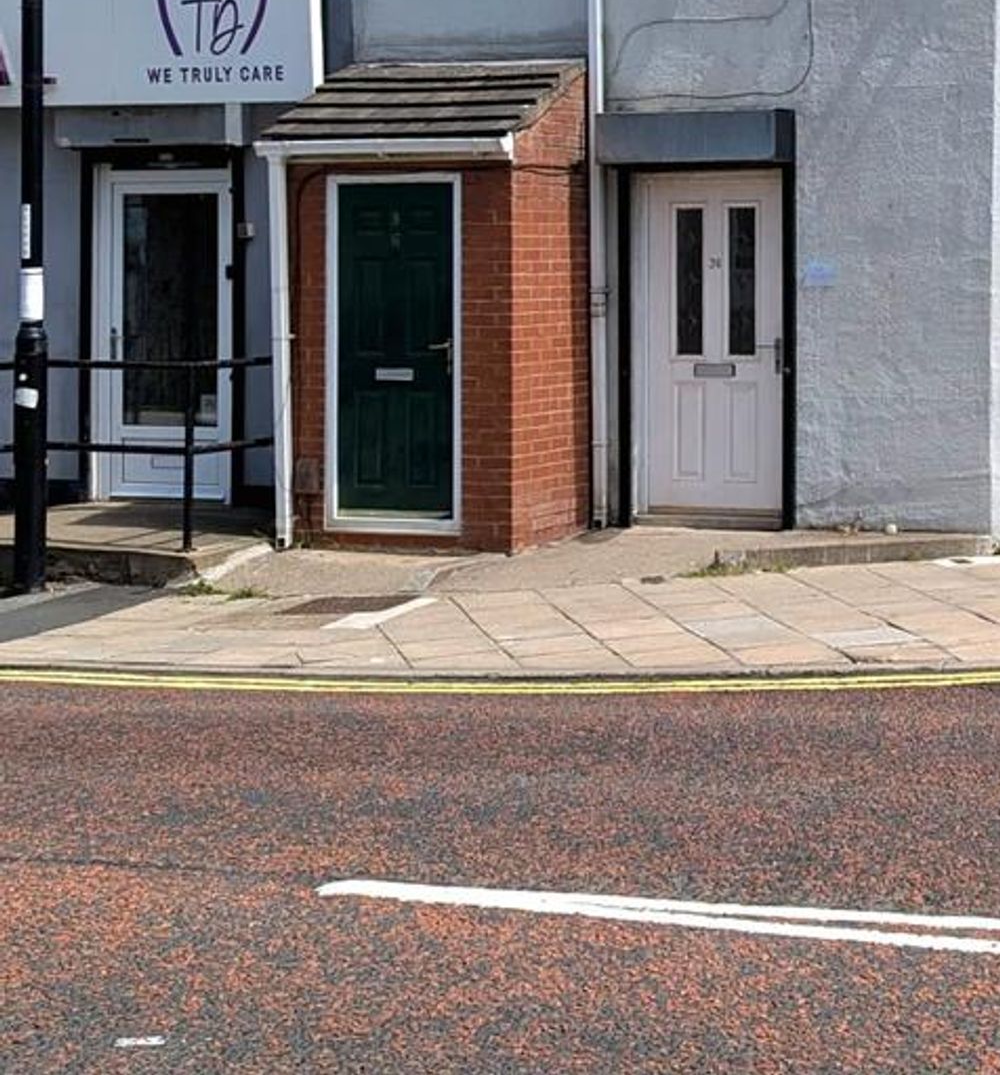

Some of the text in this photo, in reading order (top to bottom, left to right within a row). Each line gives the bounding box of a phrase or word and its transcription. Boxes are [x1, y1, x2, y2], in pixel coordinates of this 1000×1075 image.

[147, 65, 285, 84] WE TRULY CARE
